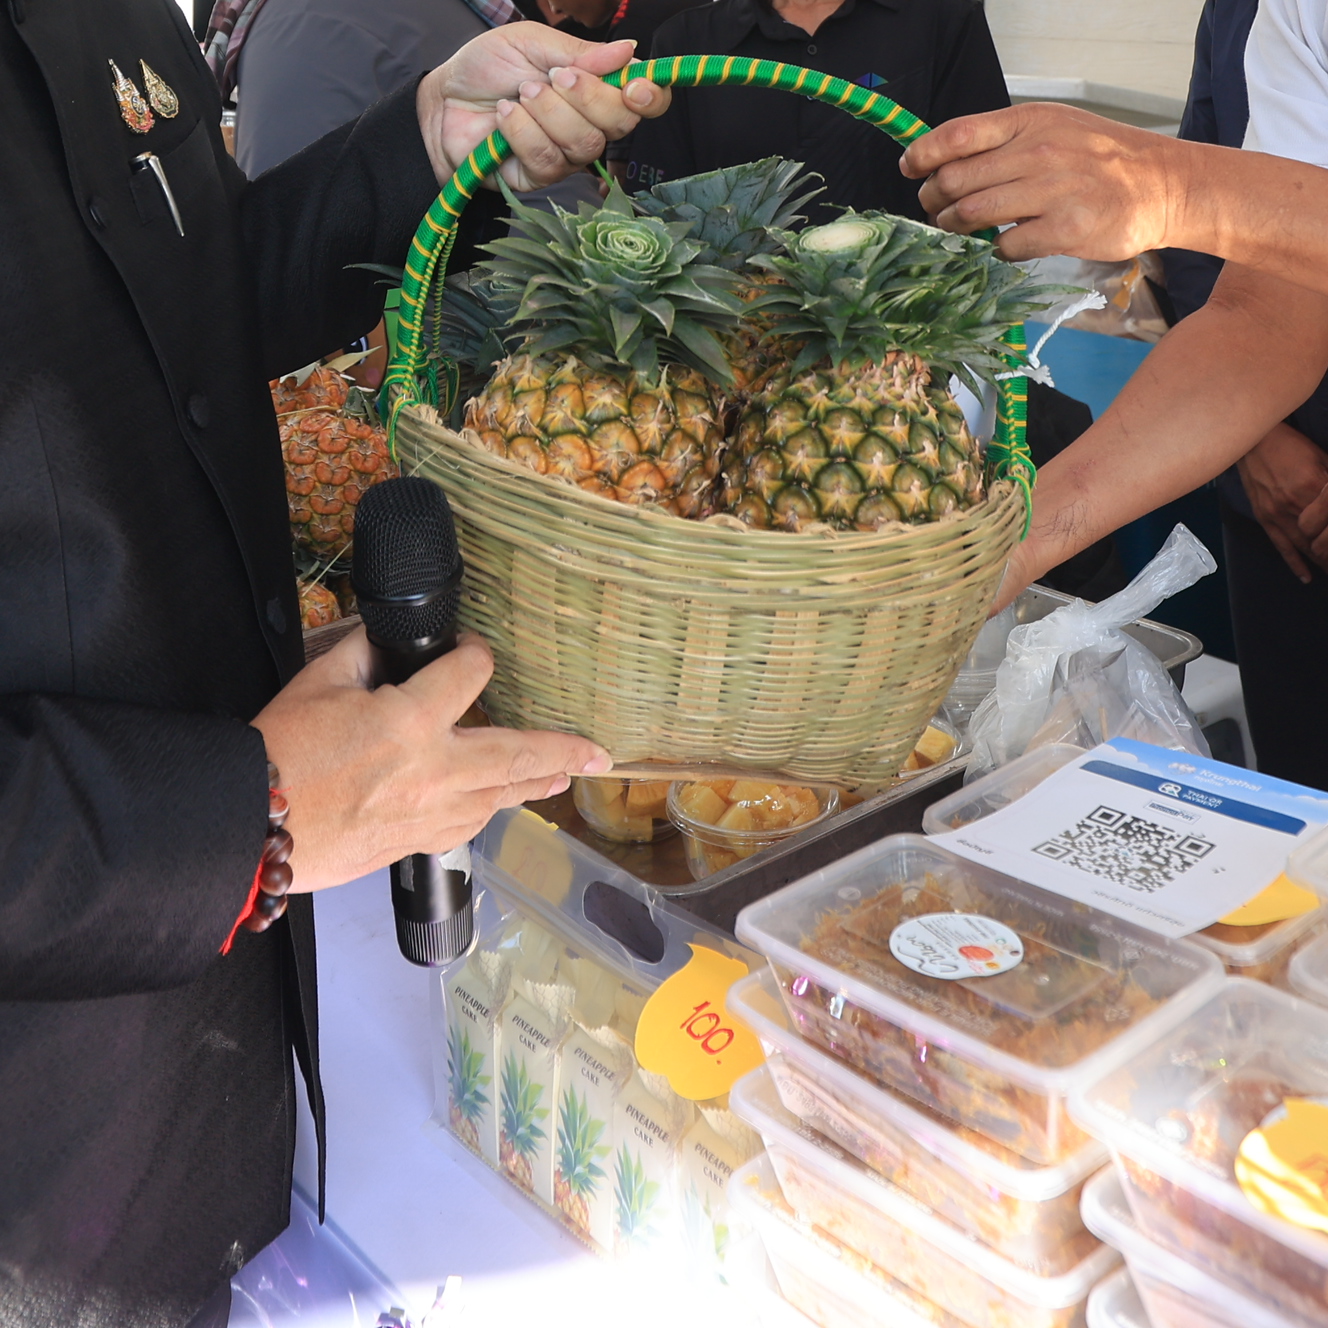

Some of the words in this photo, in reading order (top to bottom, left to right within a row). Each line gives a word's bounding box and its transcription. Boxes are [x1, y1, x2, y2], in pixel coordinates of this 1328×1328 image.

[1200, 769, 1262, 792] Krungthai
[1182, 794, 1220, 809] PAYMENT
[1187, 789, 1209, 801] THAI
[454, 985, 490, 1019] PINEAPPLE
[460, 1004, 479, 1024] CAKE
[511, 1014, 551, 1049] PINEAPPLE
[518, 1034, 537, 1054] CAKE
[574, 1046, 617, 1082] PINEAPPLE
[580, 1066, 601, 1088] CAKE
[625, 1102, 670, 1144] PINEAPPLE
[633, 1126, 655, 1149] CAKE
[702, 1166, 725, 1189] CAKE
